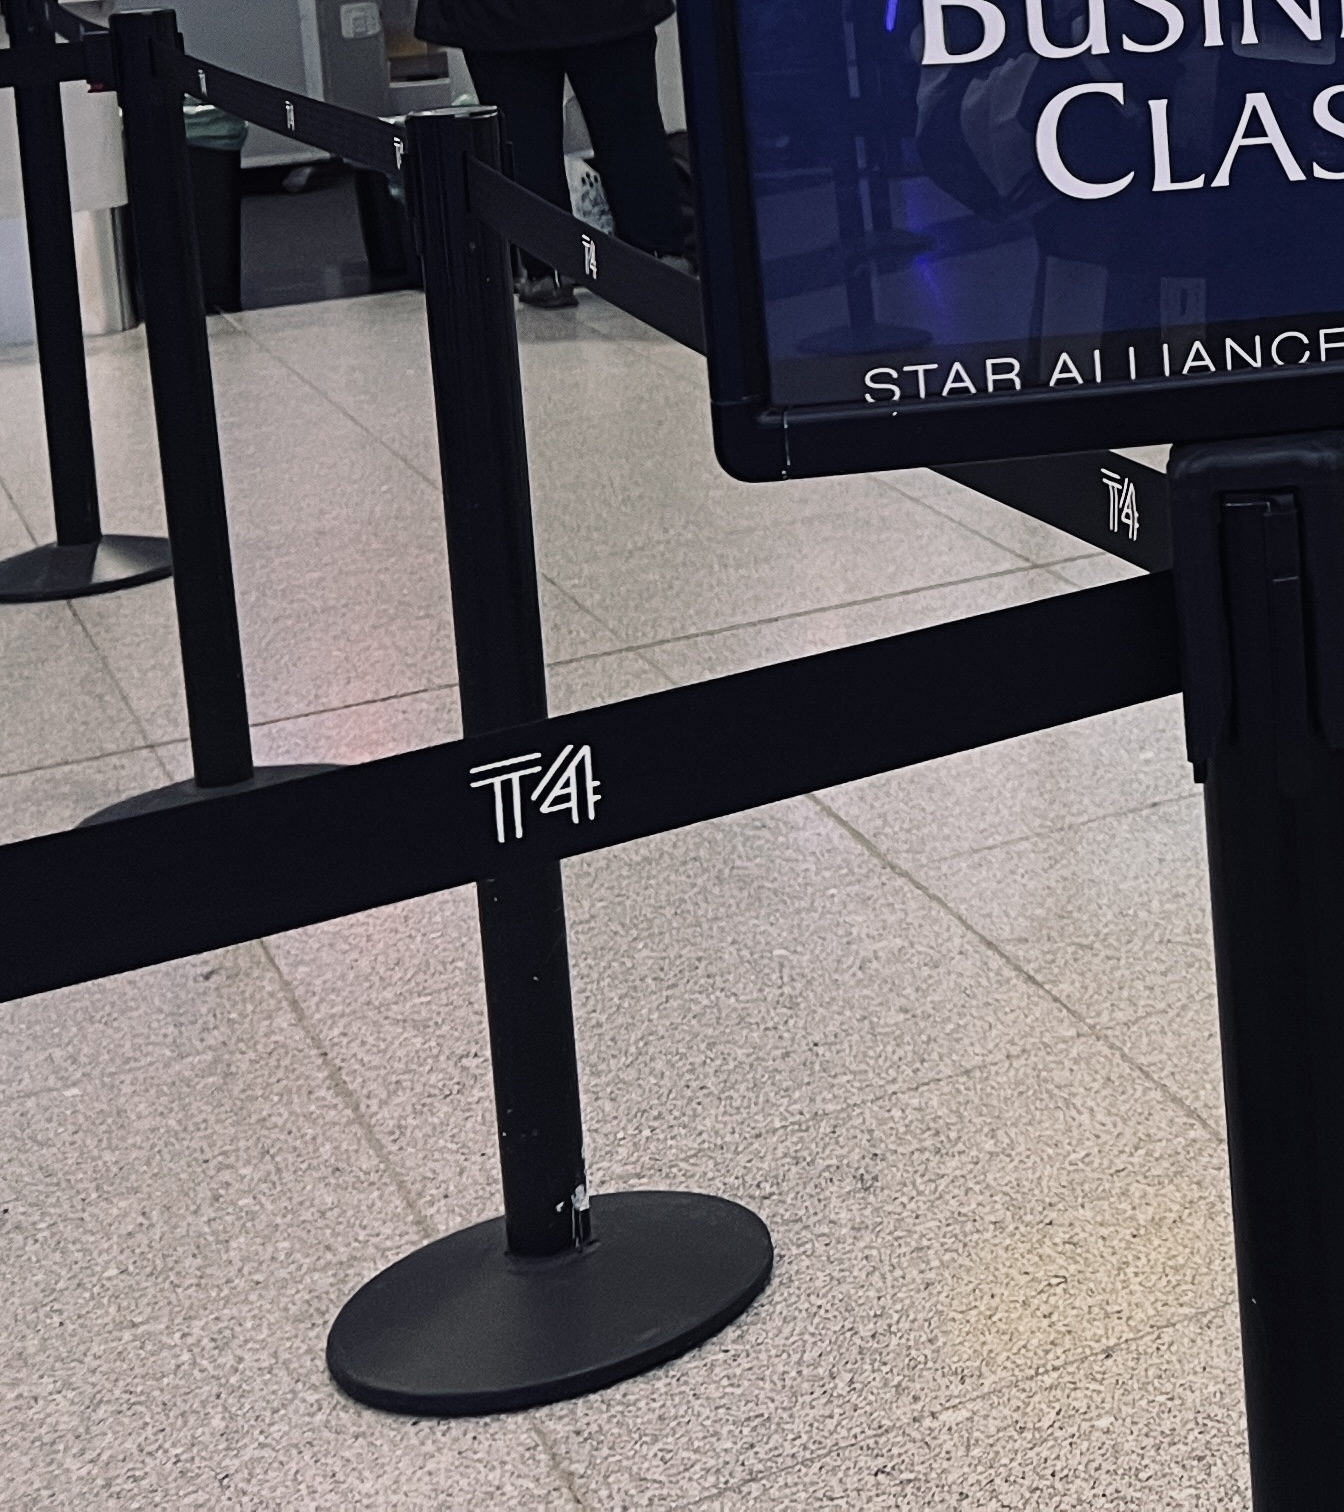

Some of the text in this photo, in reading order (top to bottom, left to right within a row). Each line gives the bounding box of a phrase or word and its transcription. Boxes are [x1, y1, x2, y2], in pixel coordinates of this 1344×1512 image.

[863, 356, 1022, 404] STAR
[1101, 465, 1140, 542] T4
[470, 744, 602, 845] T4
